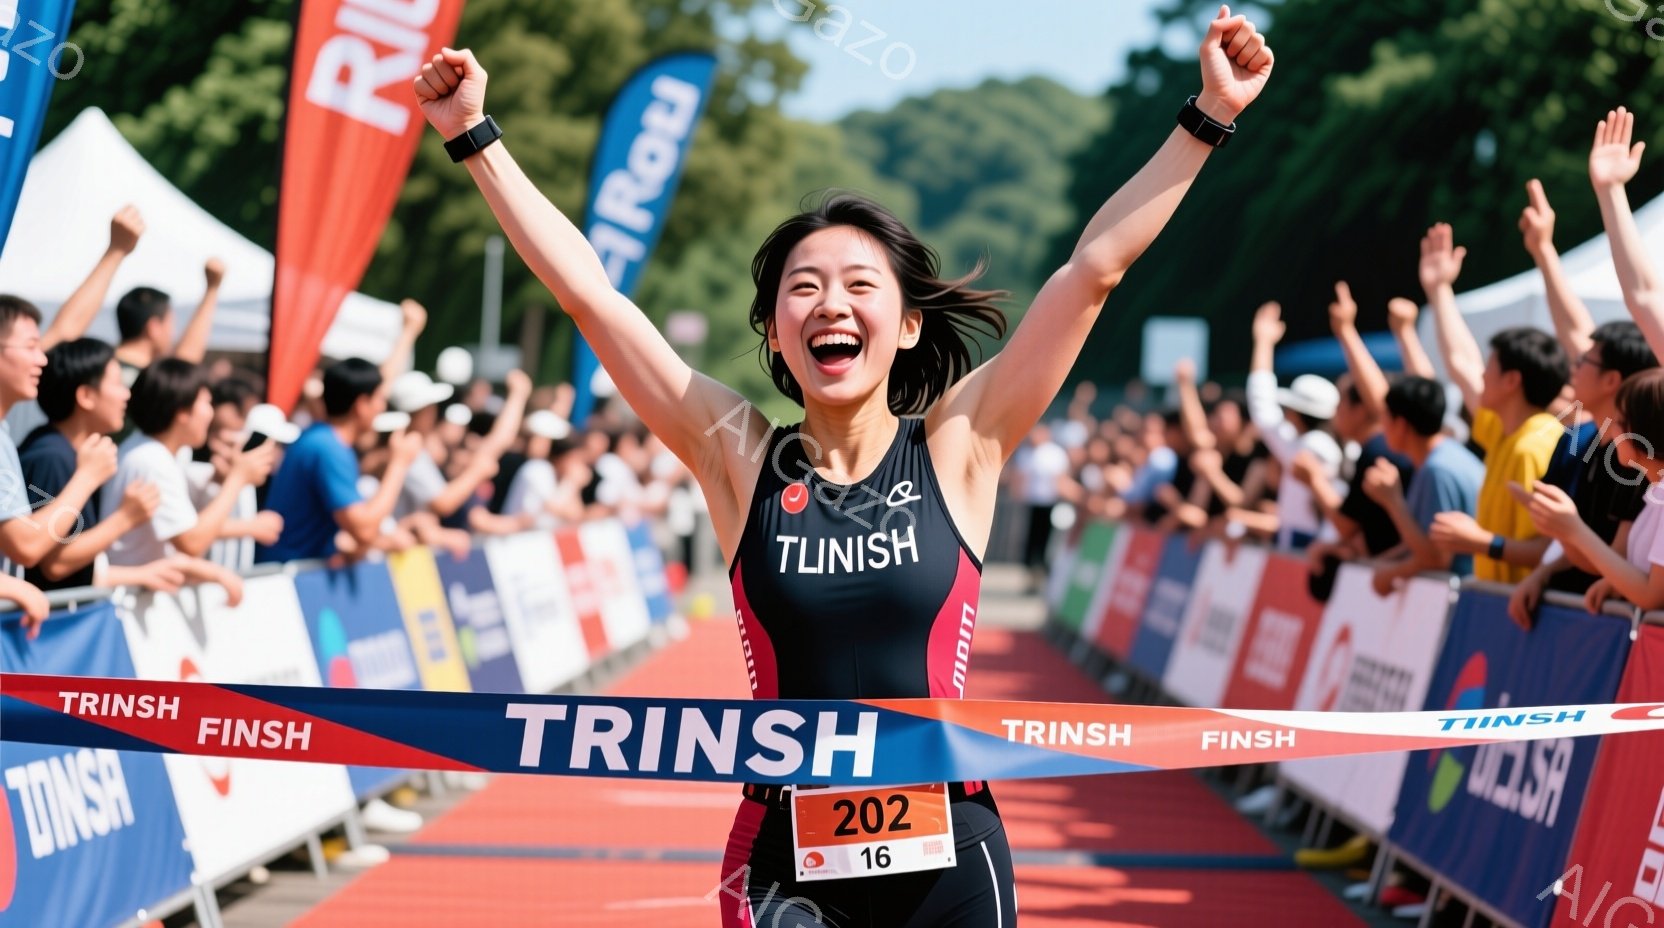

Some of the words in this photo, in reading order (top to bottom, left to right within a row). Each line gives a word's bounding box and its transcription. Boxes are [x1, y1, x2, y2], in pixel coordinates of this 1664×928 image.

[58, 691, 180, 720] TRINSH
[197, 717, 312, 750] FINSH
[505, 703, 879, 777] TRINSH
[1001, 719, 1132, 746] TRINSH
[1201, 730, 1296, 750] FINSH
[833, 794, 911, 837] 202
[860, 846, 891, 870] 16
